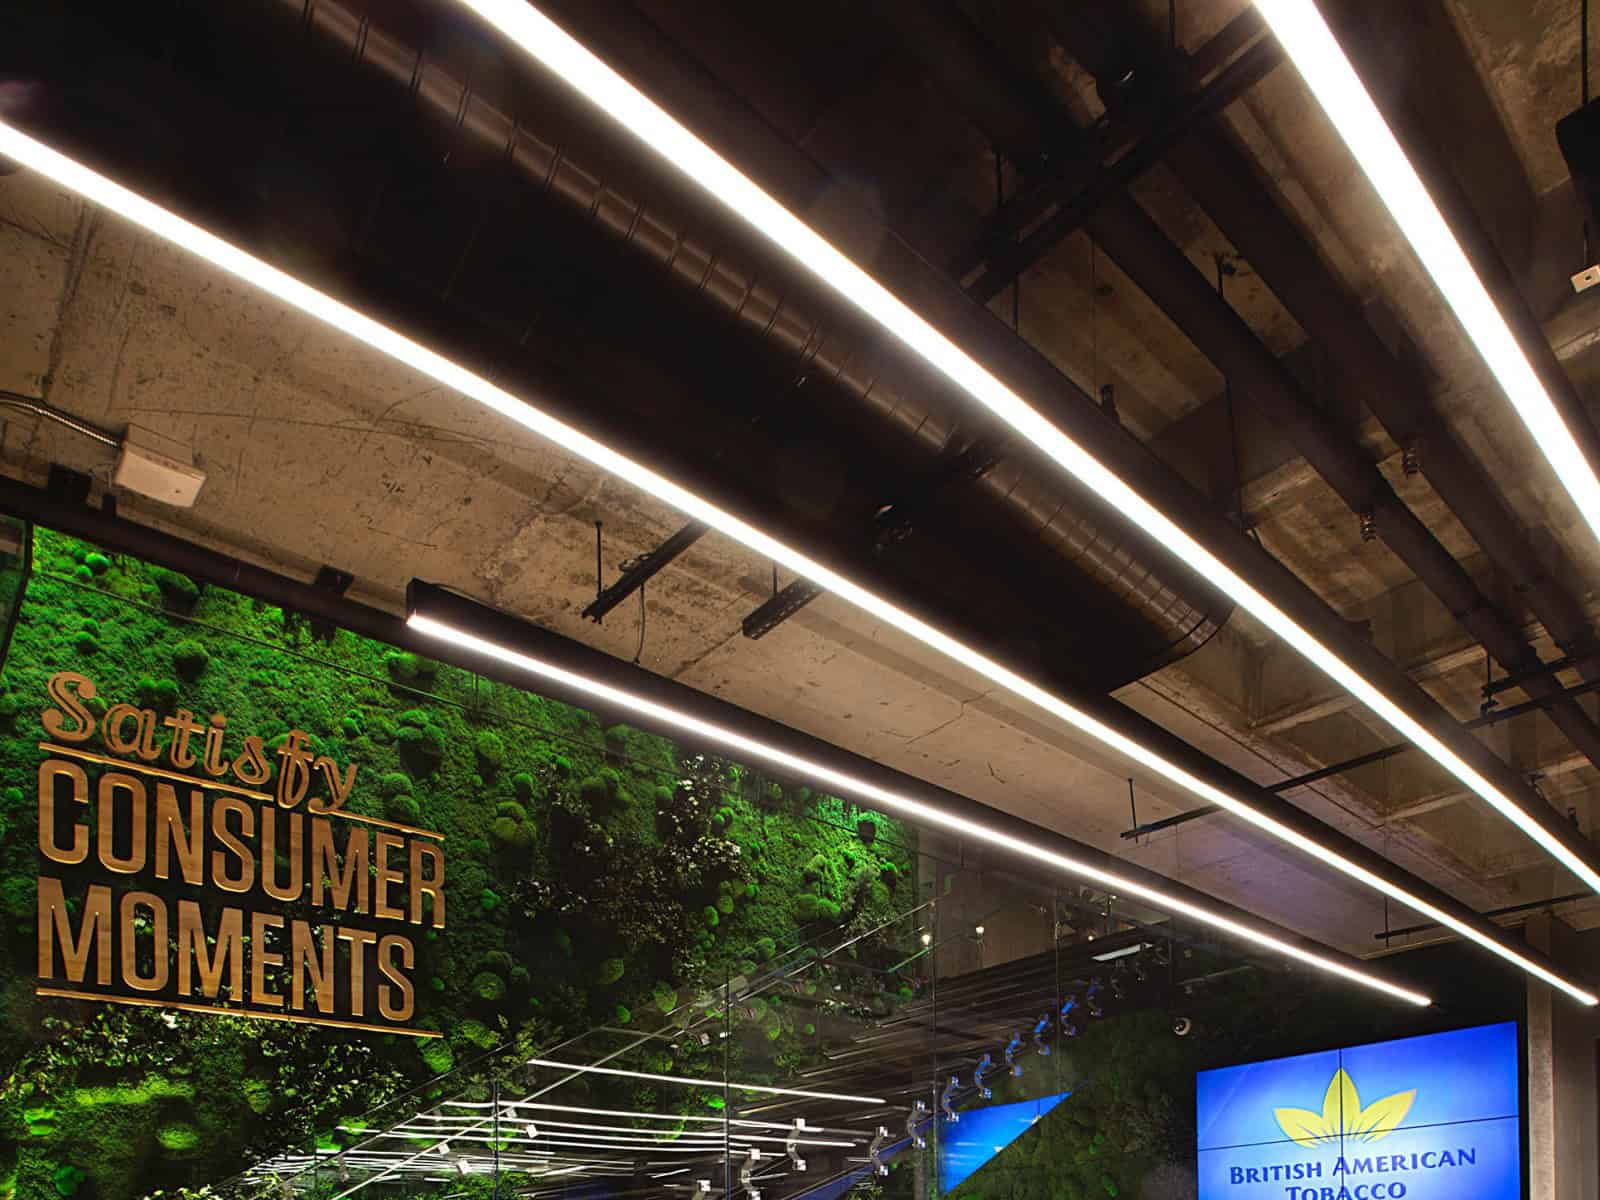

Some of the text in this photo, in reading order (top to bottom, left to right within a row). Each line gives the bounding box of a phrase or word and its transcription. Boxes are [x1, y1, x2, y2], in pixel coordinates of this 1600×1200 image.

[41, 671, 358, 813] Satisfy
[38, 759, 446, 929] CONSUMER
[37, 875, 415, 1022] MOMENTS
[1230, 1148, 1476, 1184] BRITISH AMERICAN
